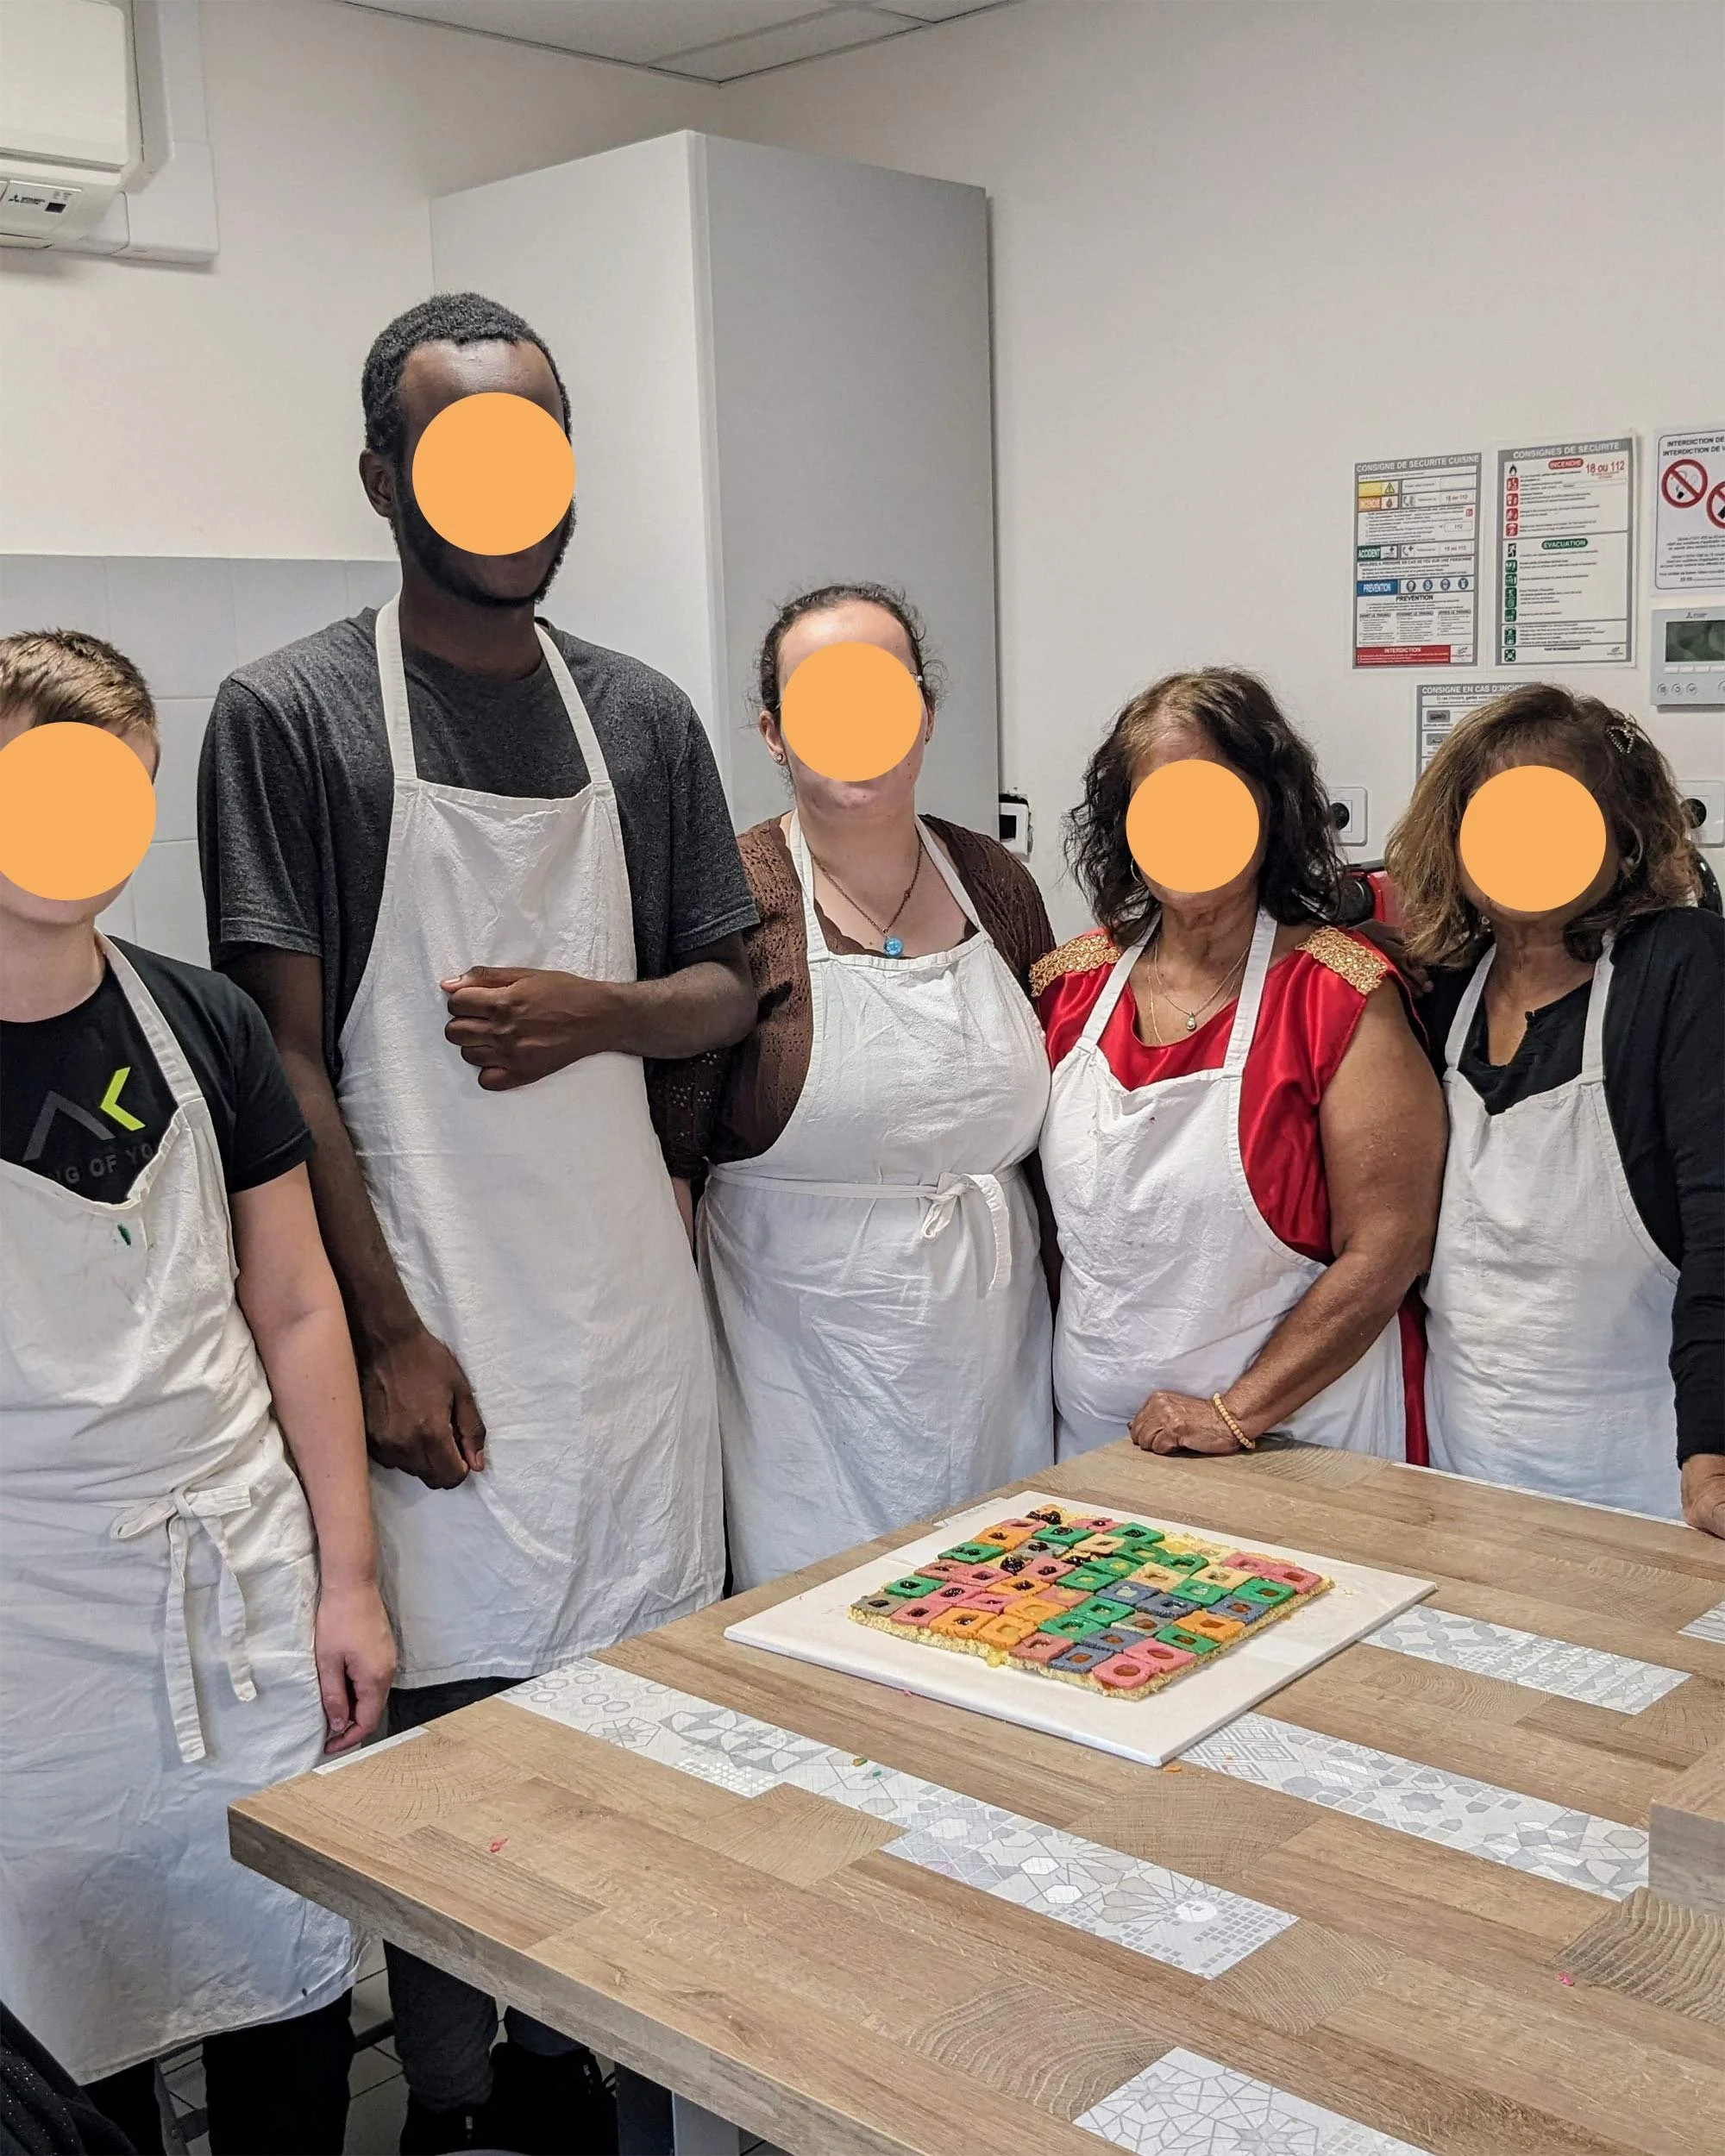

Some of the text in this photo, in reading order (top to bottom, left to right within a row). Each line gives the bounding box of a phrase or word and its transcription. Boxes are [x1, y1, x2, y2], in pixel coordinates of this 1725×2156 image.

[1667, 438, 1714, 448] INTERDICTION
[1513, 442, 1620, 459] CONSIGNES DE SECURITE
[1662, 447, 1709, 456] INTERDICTION
[1357, 454, 1479, 473] CONSIGNE DE SECURITE CUISINE
[1550, 460, 1583, 468] INCENDIE
[1586, 461, 1625, 473] 18 ou 112
[1543, 539, 1586, 548] EVACUATION
[1358, 548, 1380, 559] ACCIDENT
[1363, 582, 1391, 593] PREVENTION
[1422, 686, 1461, 694] CONSIGNE
[1463, 685, 1473, 693] EN
[89, 1155, 116, 1177] OF
